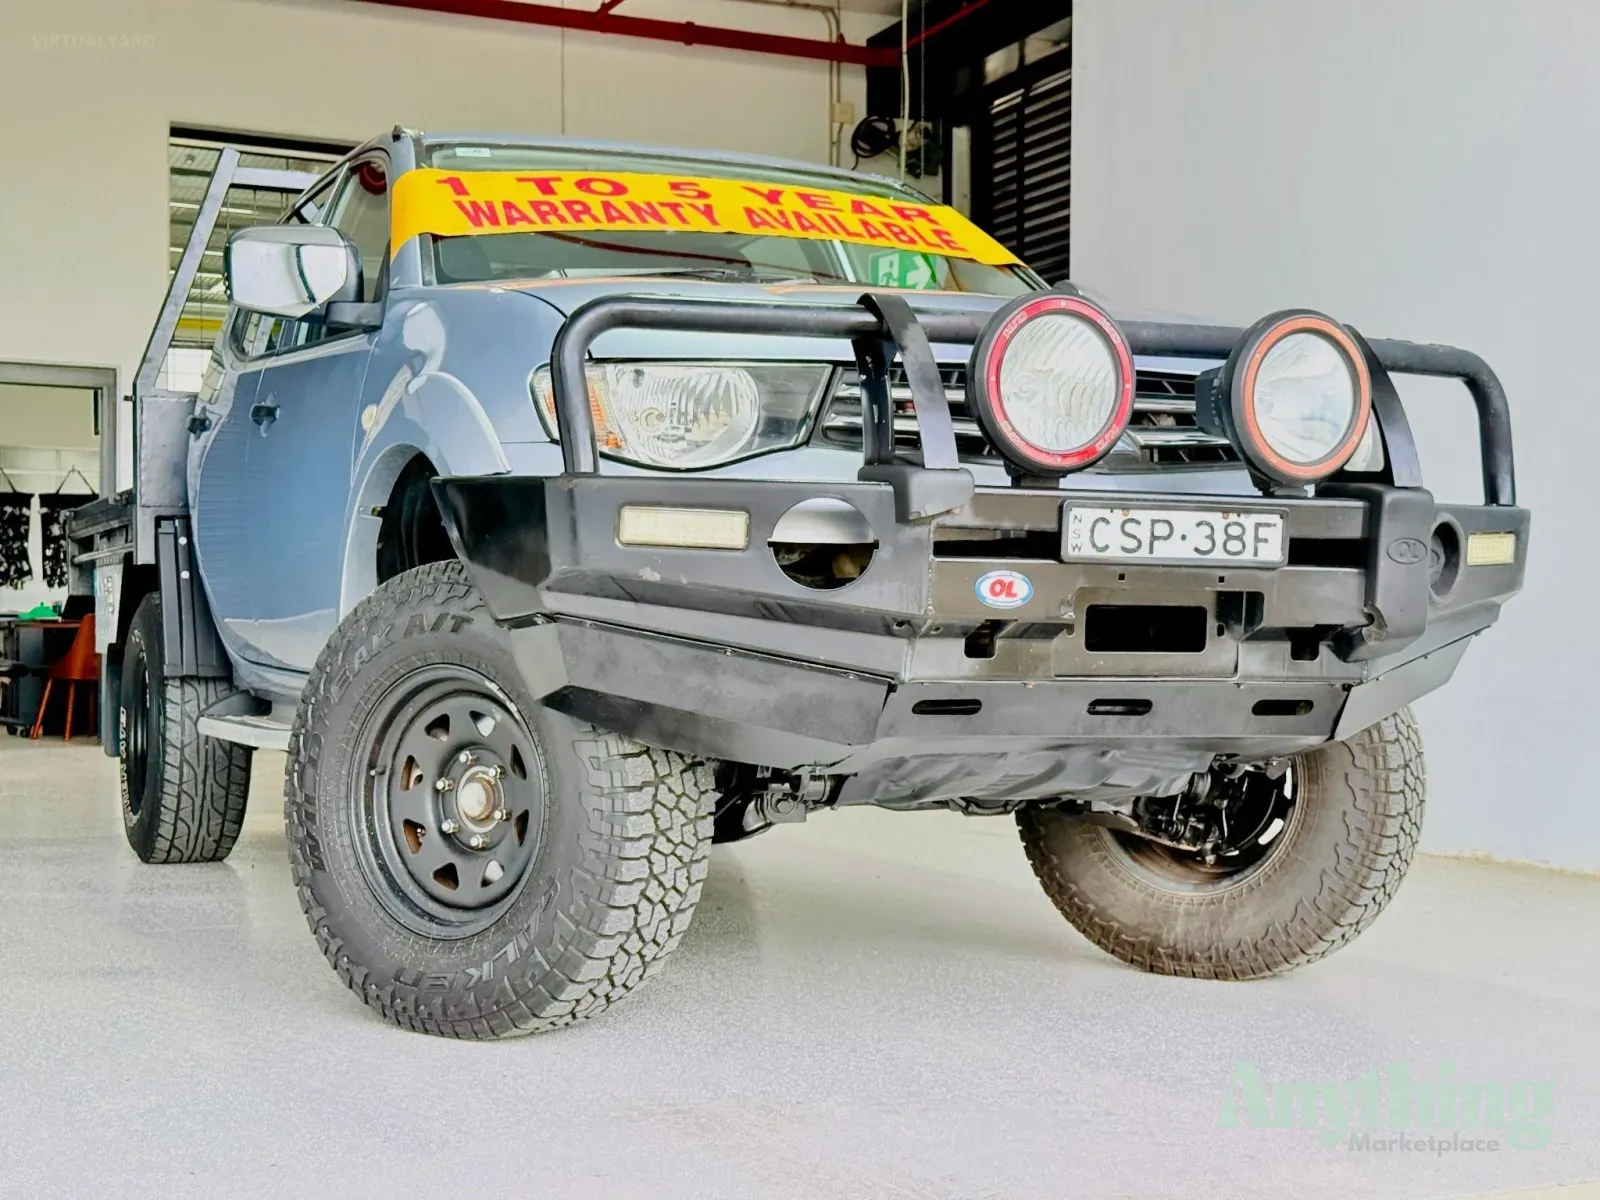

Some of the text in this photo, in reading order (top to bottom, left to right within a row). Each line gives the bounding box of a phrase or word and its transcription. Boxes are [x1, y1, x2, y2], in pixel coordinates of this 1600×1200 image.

[436, 176, 942, 226] 1 TO 5 YEAR
[452, 199, 970, 253] WARRANTY AVAILABLE
[989, 578, 1018, 598] OL
